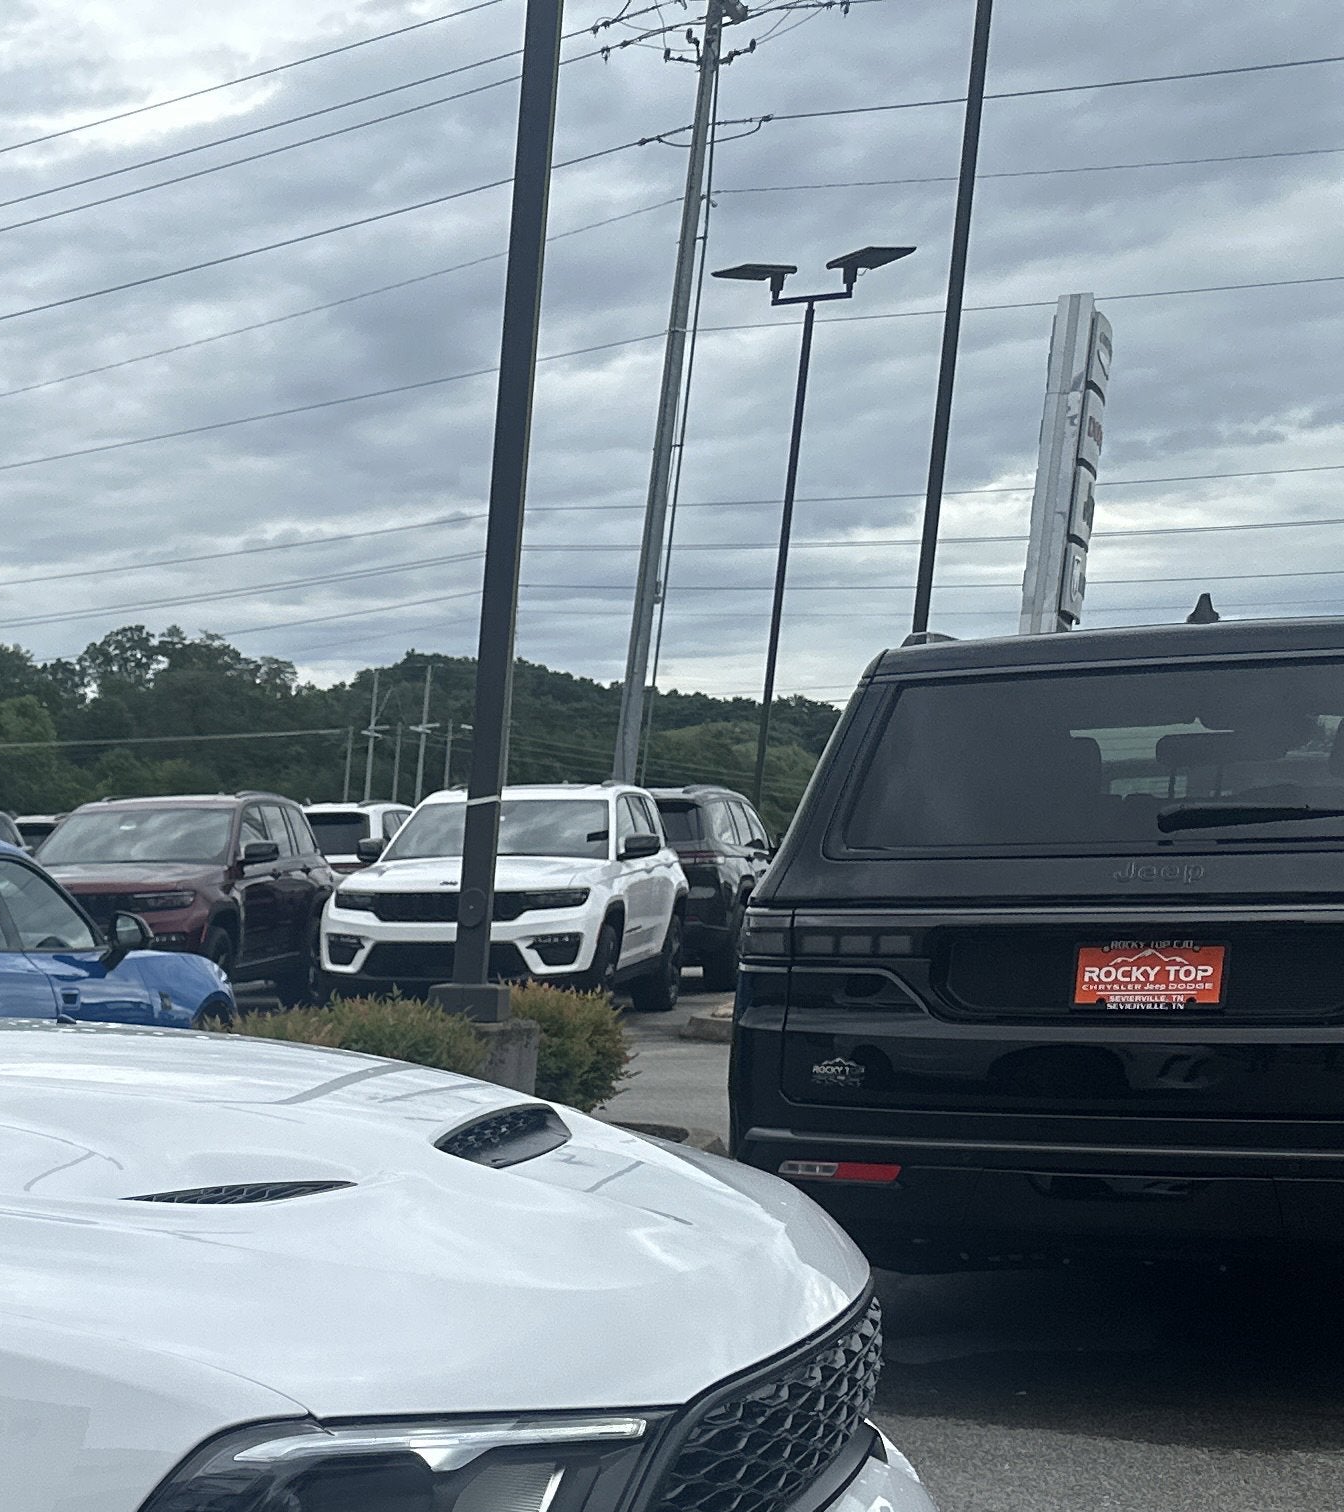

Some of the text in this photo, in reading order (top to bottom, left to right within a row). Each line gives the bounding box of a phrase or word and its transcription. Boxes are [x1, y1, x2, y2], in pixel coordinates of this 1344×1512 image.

[1113, 861, 1205, 884] Jeep
[1084, 965, 1214, 982] ROCKY TOP
[1143, 983, 1167, 991] Jeep
[1168, 982, 1214, 990] DODGE
